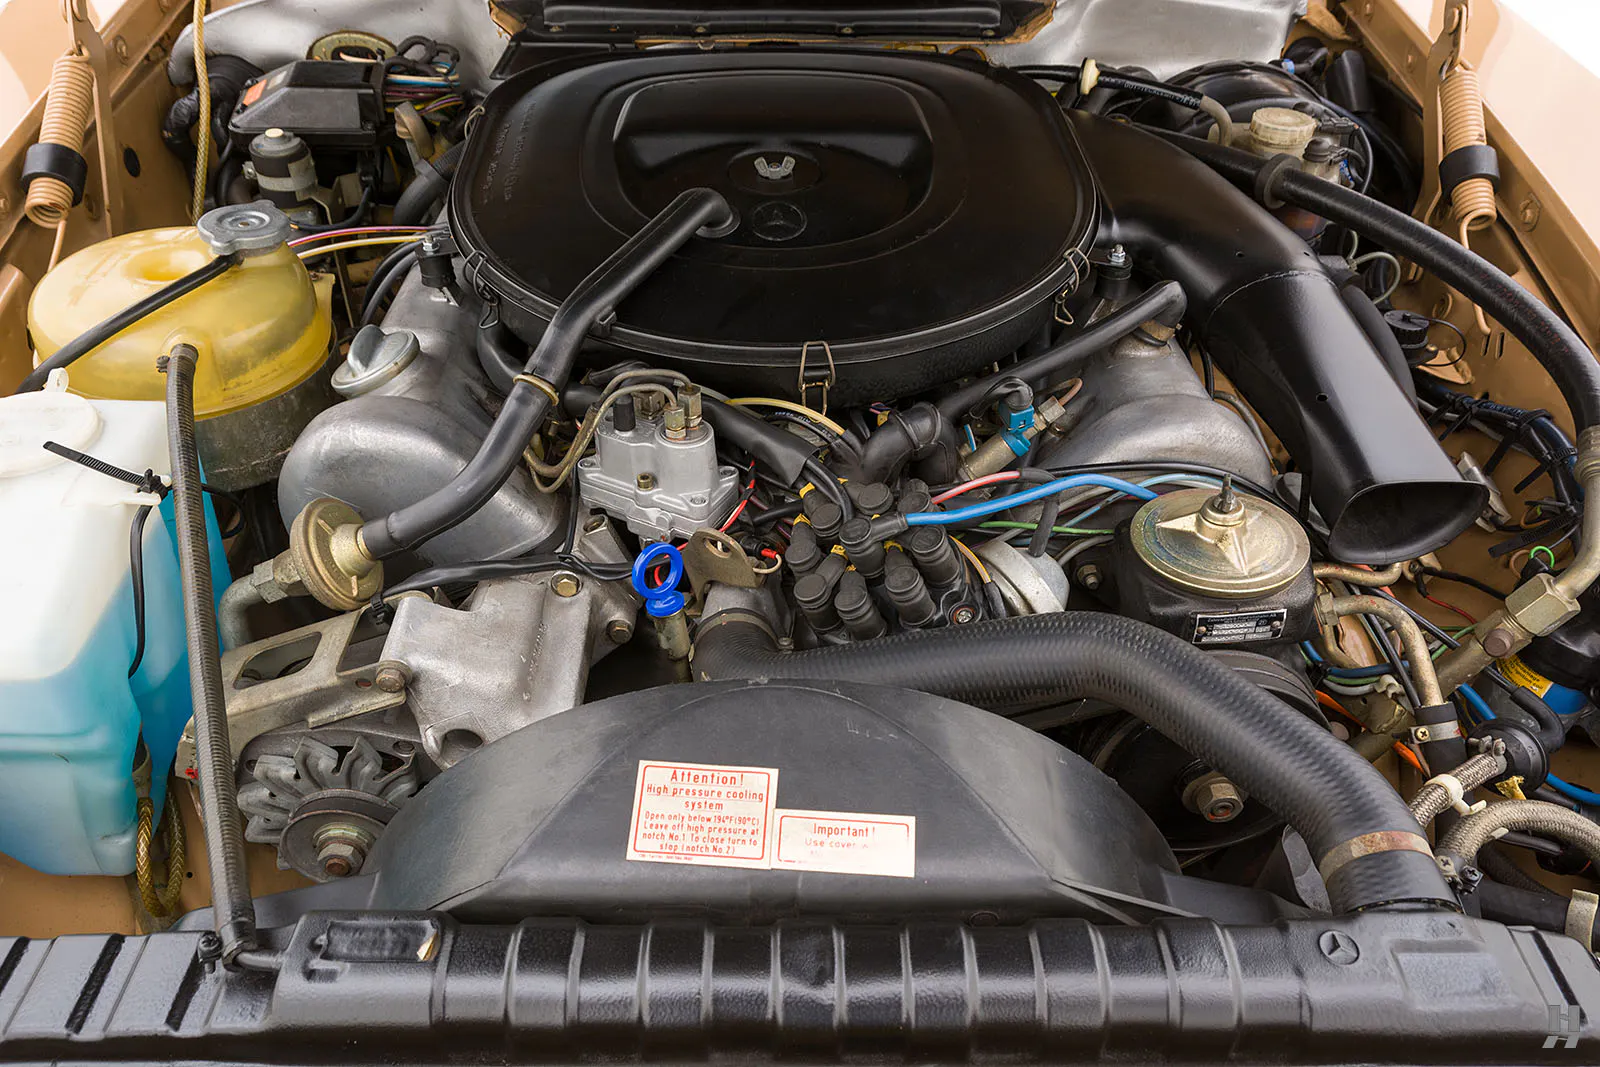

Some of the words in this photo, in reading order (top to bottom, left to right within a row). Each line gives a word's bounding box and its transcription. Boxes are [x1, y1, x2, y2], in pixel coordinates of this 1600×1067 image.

[671, 770, 744, 786] Attention!
[647, 784, 669, 796] High
[672, 786, 722, 798] pressure
[726, 789, 764, 803] cooling
[685, 800, 723, 811] system
[645, 811, 665, 822] Open
[668, 813, 685, 823] only
[688, 813, 711, 823] below
[644, 821, 669, 830] Leave
[672, 822, 685, 831] off
[687, 823, 704, 834] high
[708, 826, 747, 837] pressure
[751, 828, 759, 836] at
[642, 832, 665, 841] notch
[691, 833, 700, 843] To
[702, 834, 724, 844] close
[728, 836, 746, 846] turn
[749, 838, 758, 847] to
[805, 838, 825, 847] Use
[829, 840, 856, 849] cover
[660, 842, 679, 853] stop
